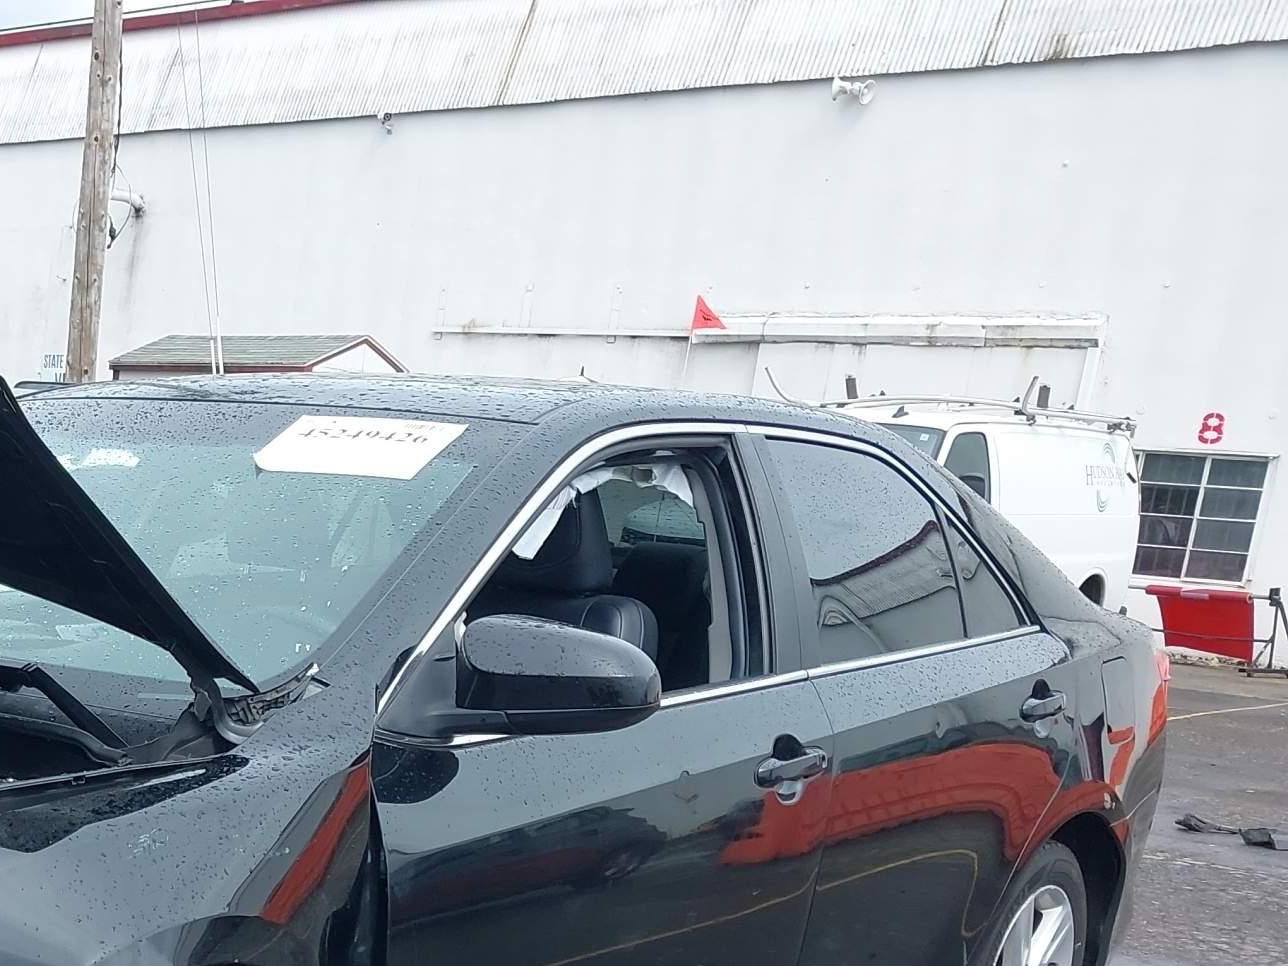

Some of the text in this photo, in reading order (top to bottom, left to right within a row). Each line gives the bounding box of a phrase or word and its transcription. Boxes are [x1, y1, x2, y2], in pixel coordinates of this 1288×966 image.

[43, 354, 64, 369] STATE
[298, 427, 428, 443] 45249426
[1198, 412, 1225, 444] 8
